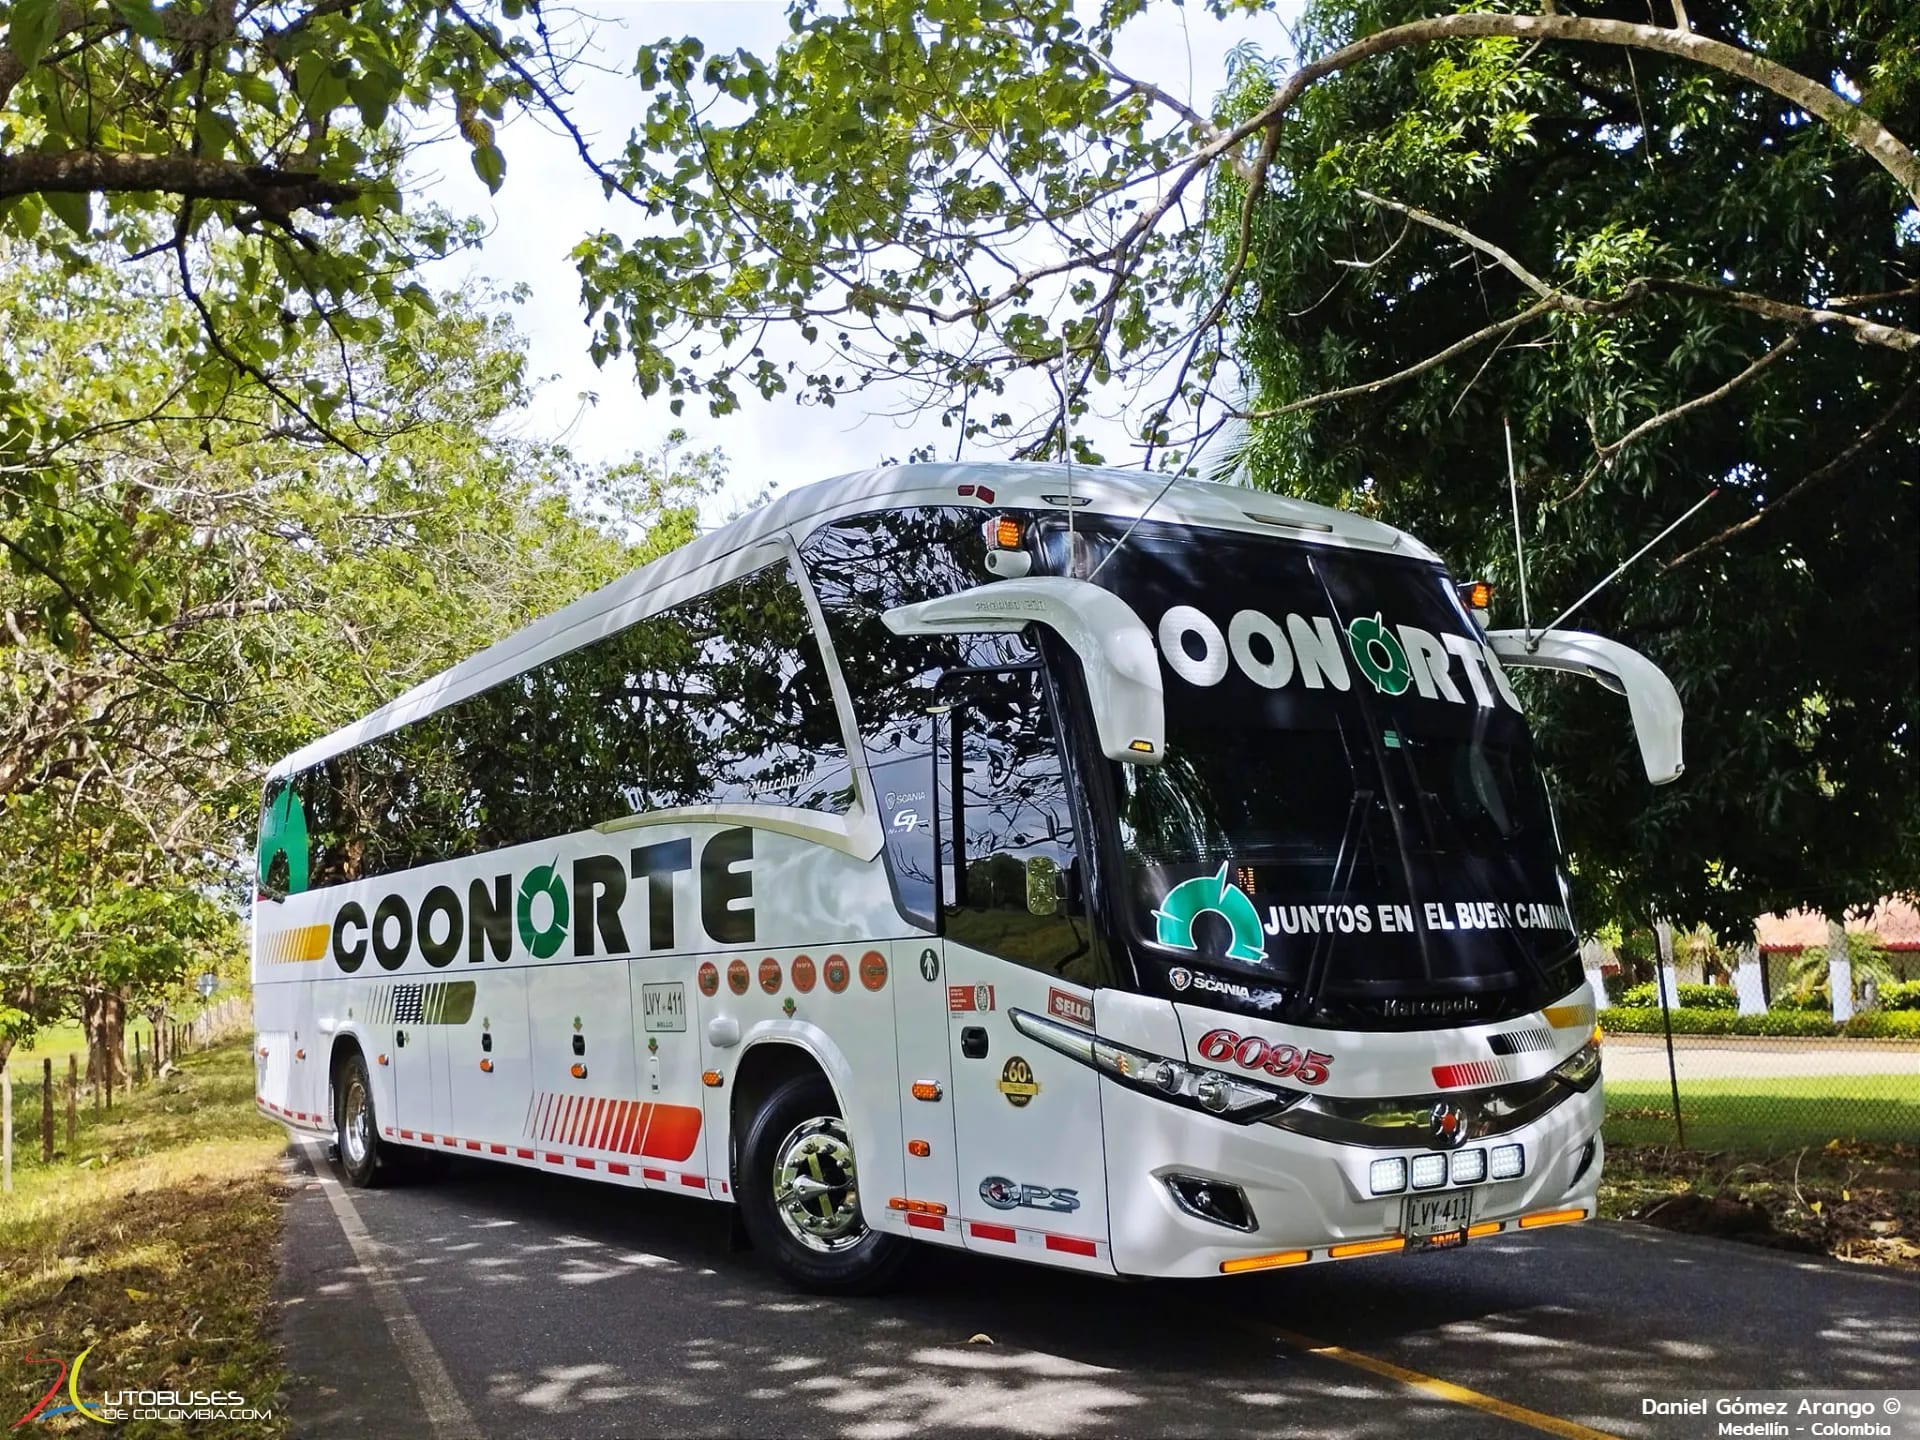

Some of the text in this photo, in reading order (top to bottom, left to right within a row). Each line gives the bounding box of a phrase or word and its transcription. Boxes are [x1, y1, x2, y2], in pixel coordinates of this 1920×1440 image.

[1158, 605, 1524, 715] OONORT
[750, 771, 815, 795] Marcopolo
[896, 791, 927, 803] SCANIA
[332, 825, 756, 974] COONORTE
[1263, 902, 1571, 935] JUNTOS EN EL BUEN CAMIN
[1194, 977, 1250, 998] SCANIA
[1054, 995, 1091, 1022] SELLO
[1384, 996, 1478, 1017] Marcopolo
[1198, 1029, 1334, 1085] 6095
[1009, 1061, 1027, 1082] 60
